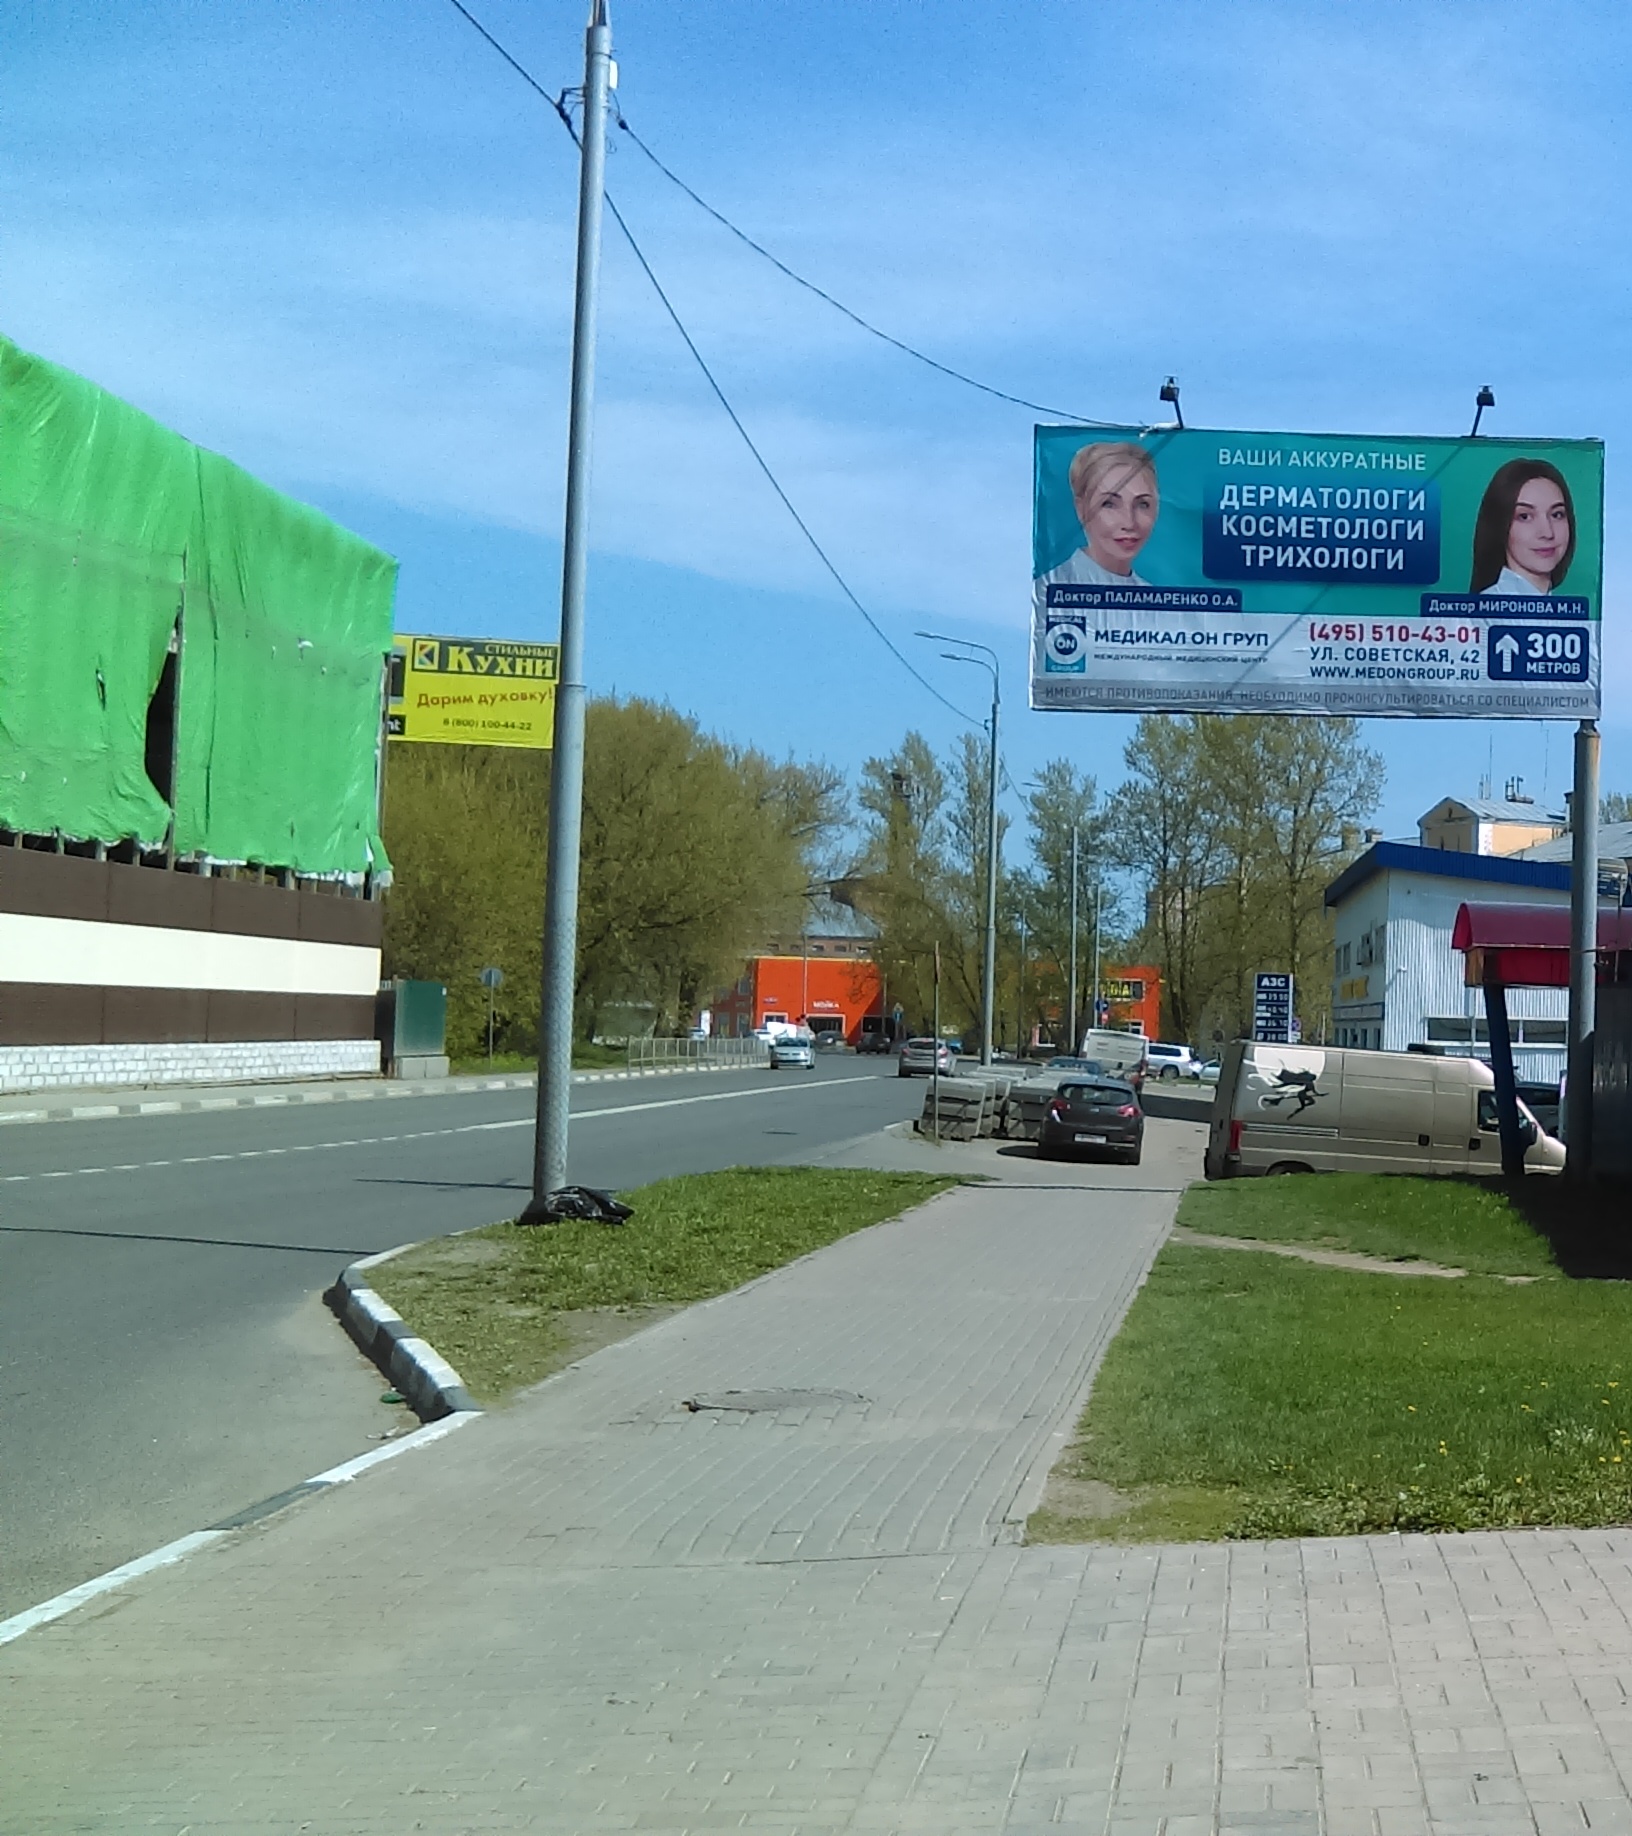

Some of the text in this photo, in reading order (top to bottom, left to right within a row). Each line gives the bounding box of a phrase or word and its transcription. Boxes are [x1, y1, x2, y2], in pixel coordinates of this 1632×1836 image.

[1218, 449, 1426, 470] ВАШИ АККУРАТНЫЕ
[1219, 484, 1425, 511] ДЕРМАТОЛОГИ
[1222, 514, 1424, 541] КОСМЕТОЛОГИ
[1241, 545, 1404, 570] ТРИХОЛОГИ
[1053, 590, 1238, 606] Доктор ПАЛАМАРЕНКО О.А.
[1429, 600, 1585, 614] Доктор МИРОНОВА М.Н.
[1094, 630, 1269, 647] МЕДИКАЛ ОН ГРУП
[1309, 622, 1481, 644] (495) 510-43-01
[484, 644, 555, 658] СТИЛЬНЫЕ
[1056, 639, 1075, 649] ON
[1527, 633, 1581, 659] 300
[1310, 647, 1480, 665] УЛ. СОВЕТСКАЯ, 42
[1310, 666, 1480, 681] WWW.MEDONGROUP.RU
[1527, 662, 1581, 675] МЕТРОВ
[417, 687, 553, 709] Дарим духовку!
[1045, 686, 1101, 699] ИМЕЮТСЯ
[1240, 690, 1321, 703] НЕОБХОДИМО
[1325, 692, 1473, 707] ПРОКОНСУЛЬТИРОВАТЬСЯ
[1477, 695, 1492, 706] СО
[1496, 695, 1589, 708] СПЕЦИАЛИСТОМ
[452, 718, 478, 729] (800)
[481, 720, 532, 731] 100-44-22
[1261, 977, 1286, 987] АЗС
